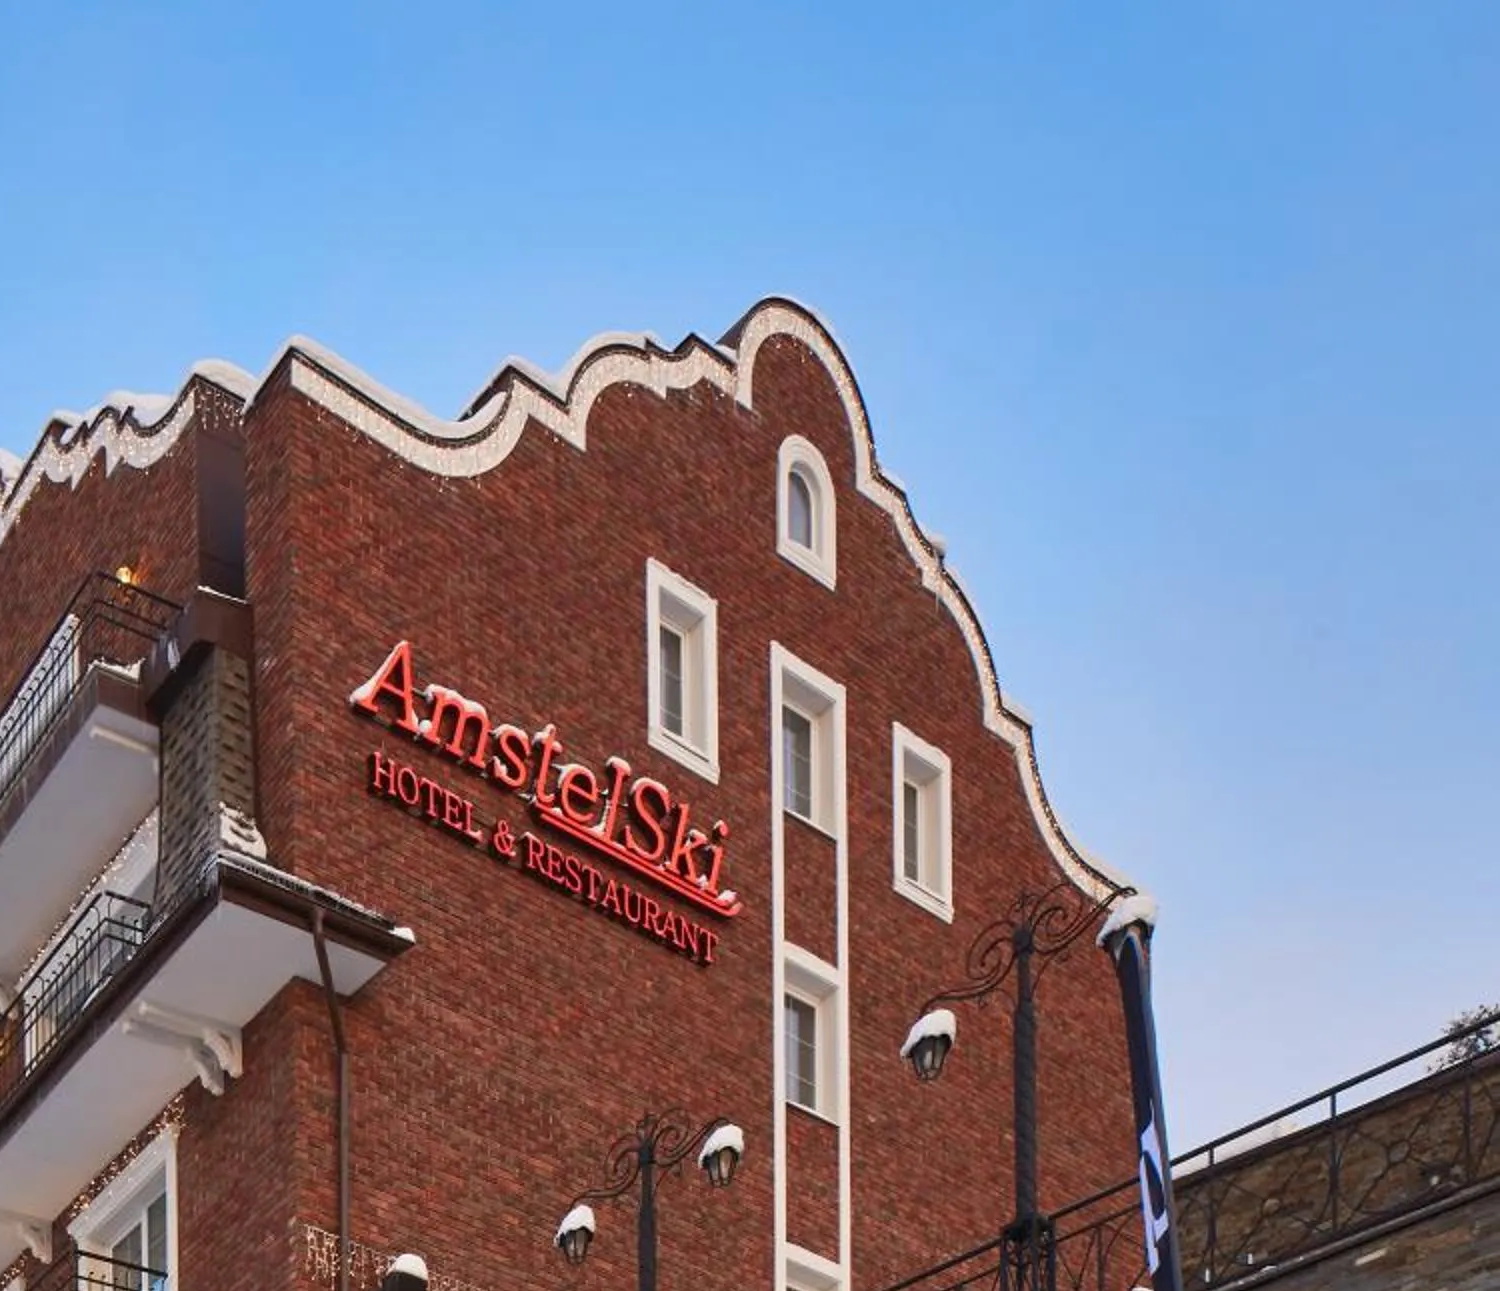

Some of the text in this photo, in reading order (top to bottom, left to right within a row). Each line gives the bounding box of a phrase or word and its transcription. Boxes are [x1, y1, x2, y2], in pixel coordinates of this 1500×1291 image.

[350, 640, 730, 896] AmstelSki
[373, 751, 718, 963] HOTEL & RESTAURANT
